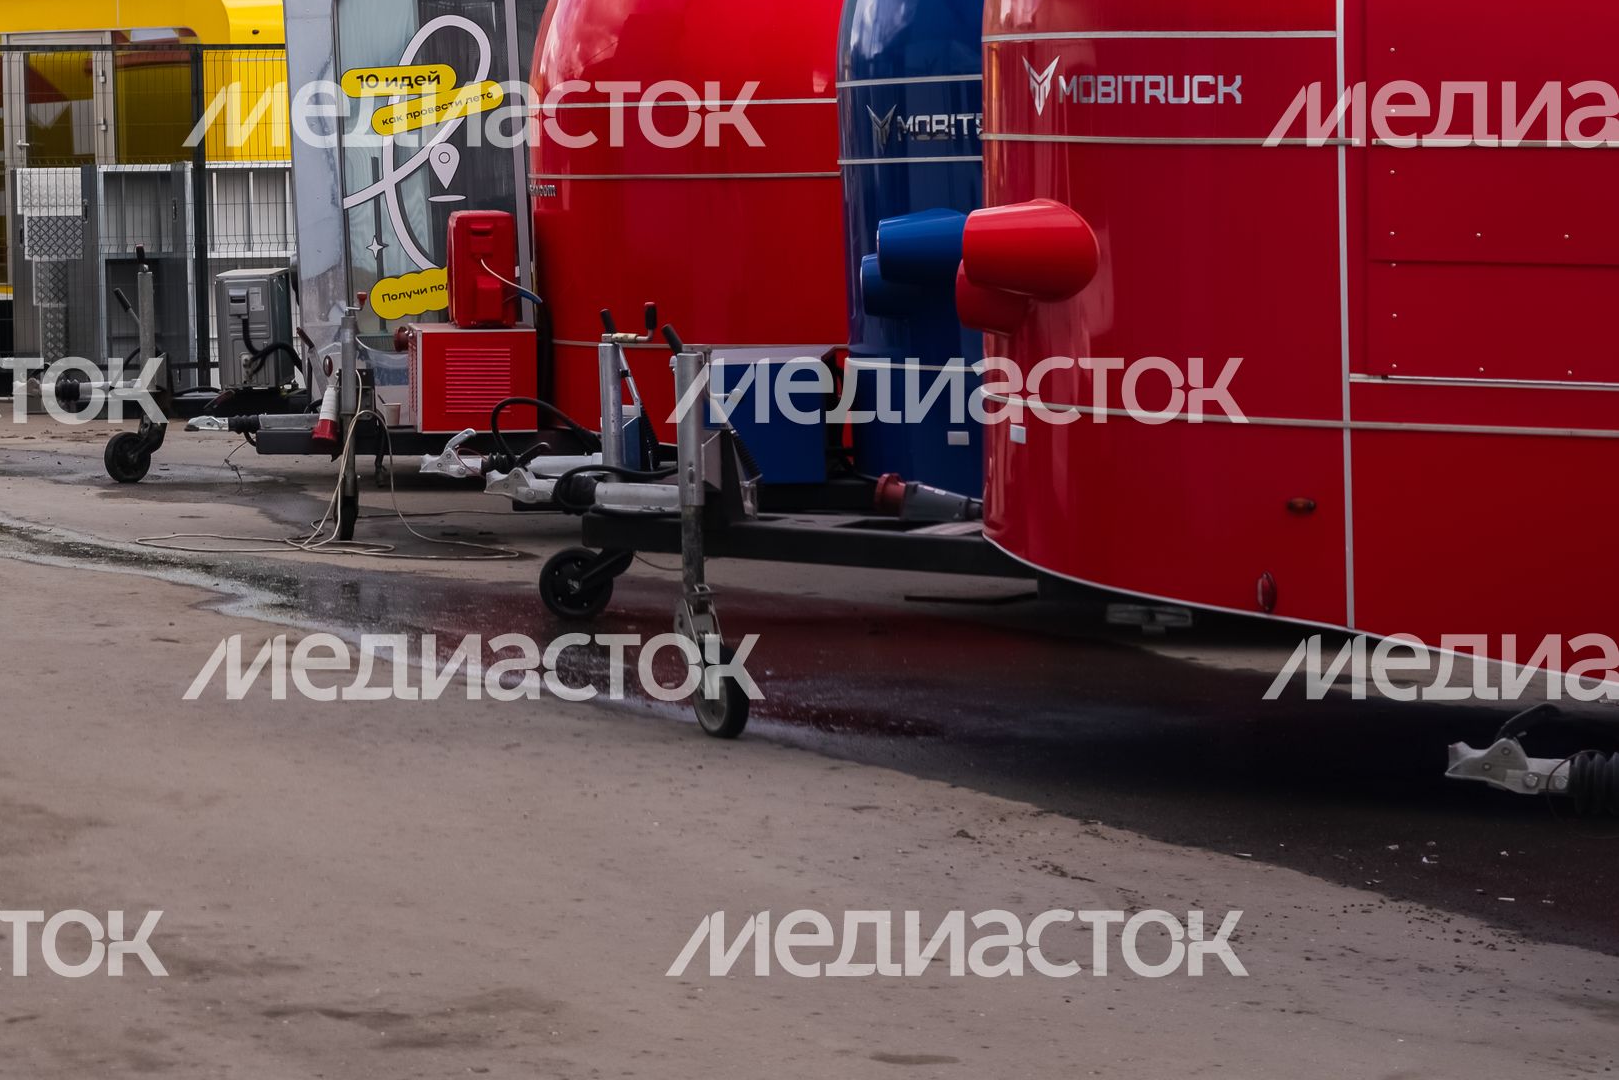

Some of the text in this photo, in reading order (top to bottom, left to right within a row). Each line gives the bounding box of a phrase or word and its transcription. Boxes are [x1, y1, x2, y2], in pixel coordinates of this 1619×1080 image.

[356, 70, 441, 90] 10 идей
[1058, 74, 1243, 105] MOBITRUCK
[382, 92, 493, 126] как провести лето
[381, 287, 428, 303] Получи
